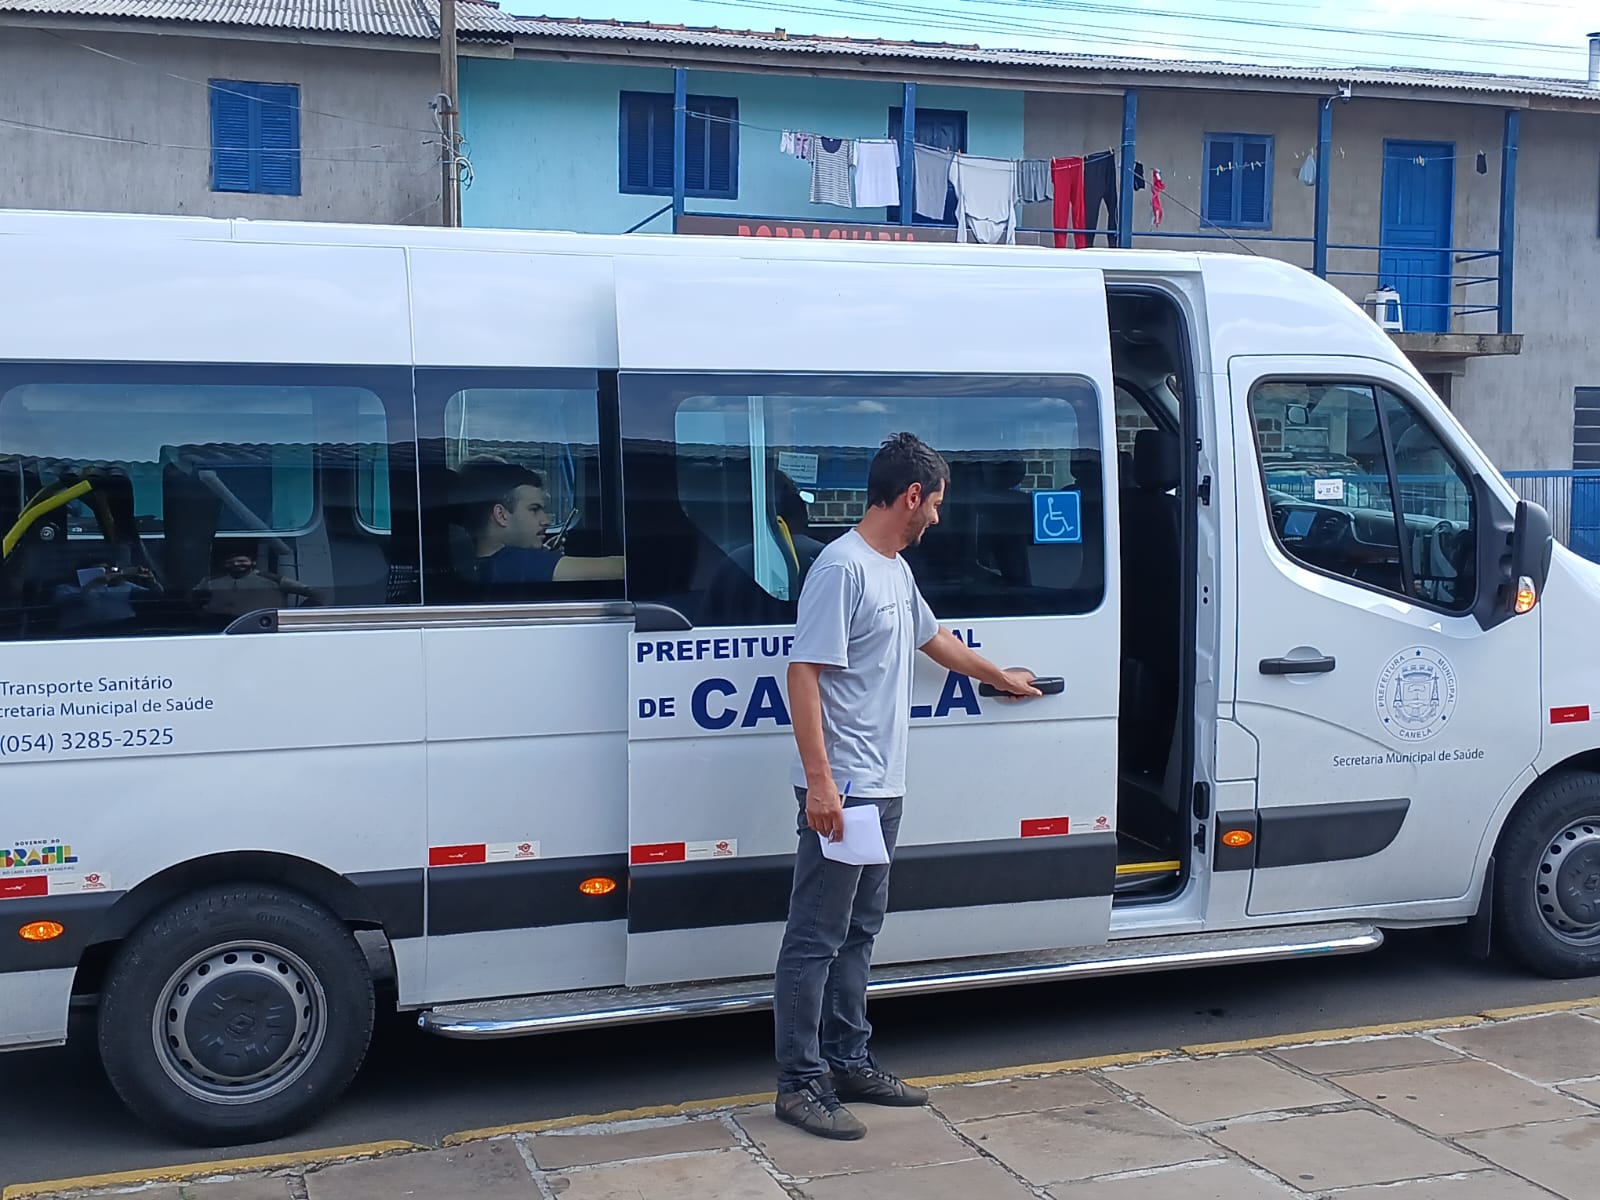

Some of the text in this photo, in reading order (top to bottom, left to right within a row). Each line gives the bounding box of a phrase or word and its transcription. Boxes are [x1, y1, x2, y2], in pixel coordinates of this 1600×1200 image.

[637, 635, 796, 663] PREFEITU
[0, 675, 173, 698] Transporte Sanitário
[1378, 655, 1406, 708] PREFEITURA
[60, 699, 137, 717] Municipal
[142, 699, 162, 713] de
[166, 696, 214, 712] Saúde
[638, 696, 676, 719] DE
[0, 727, 174, 756] (054) 3285-2525
[1399, 727, 1433, 739] CANELA
[1333, 748, 1485, 767] Secretaria Municipal de Saúde
[0, 845, 79, 867] BRASIL
